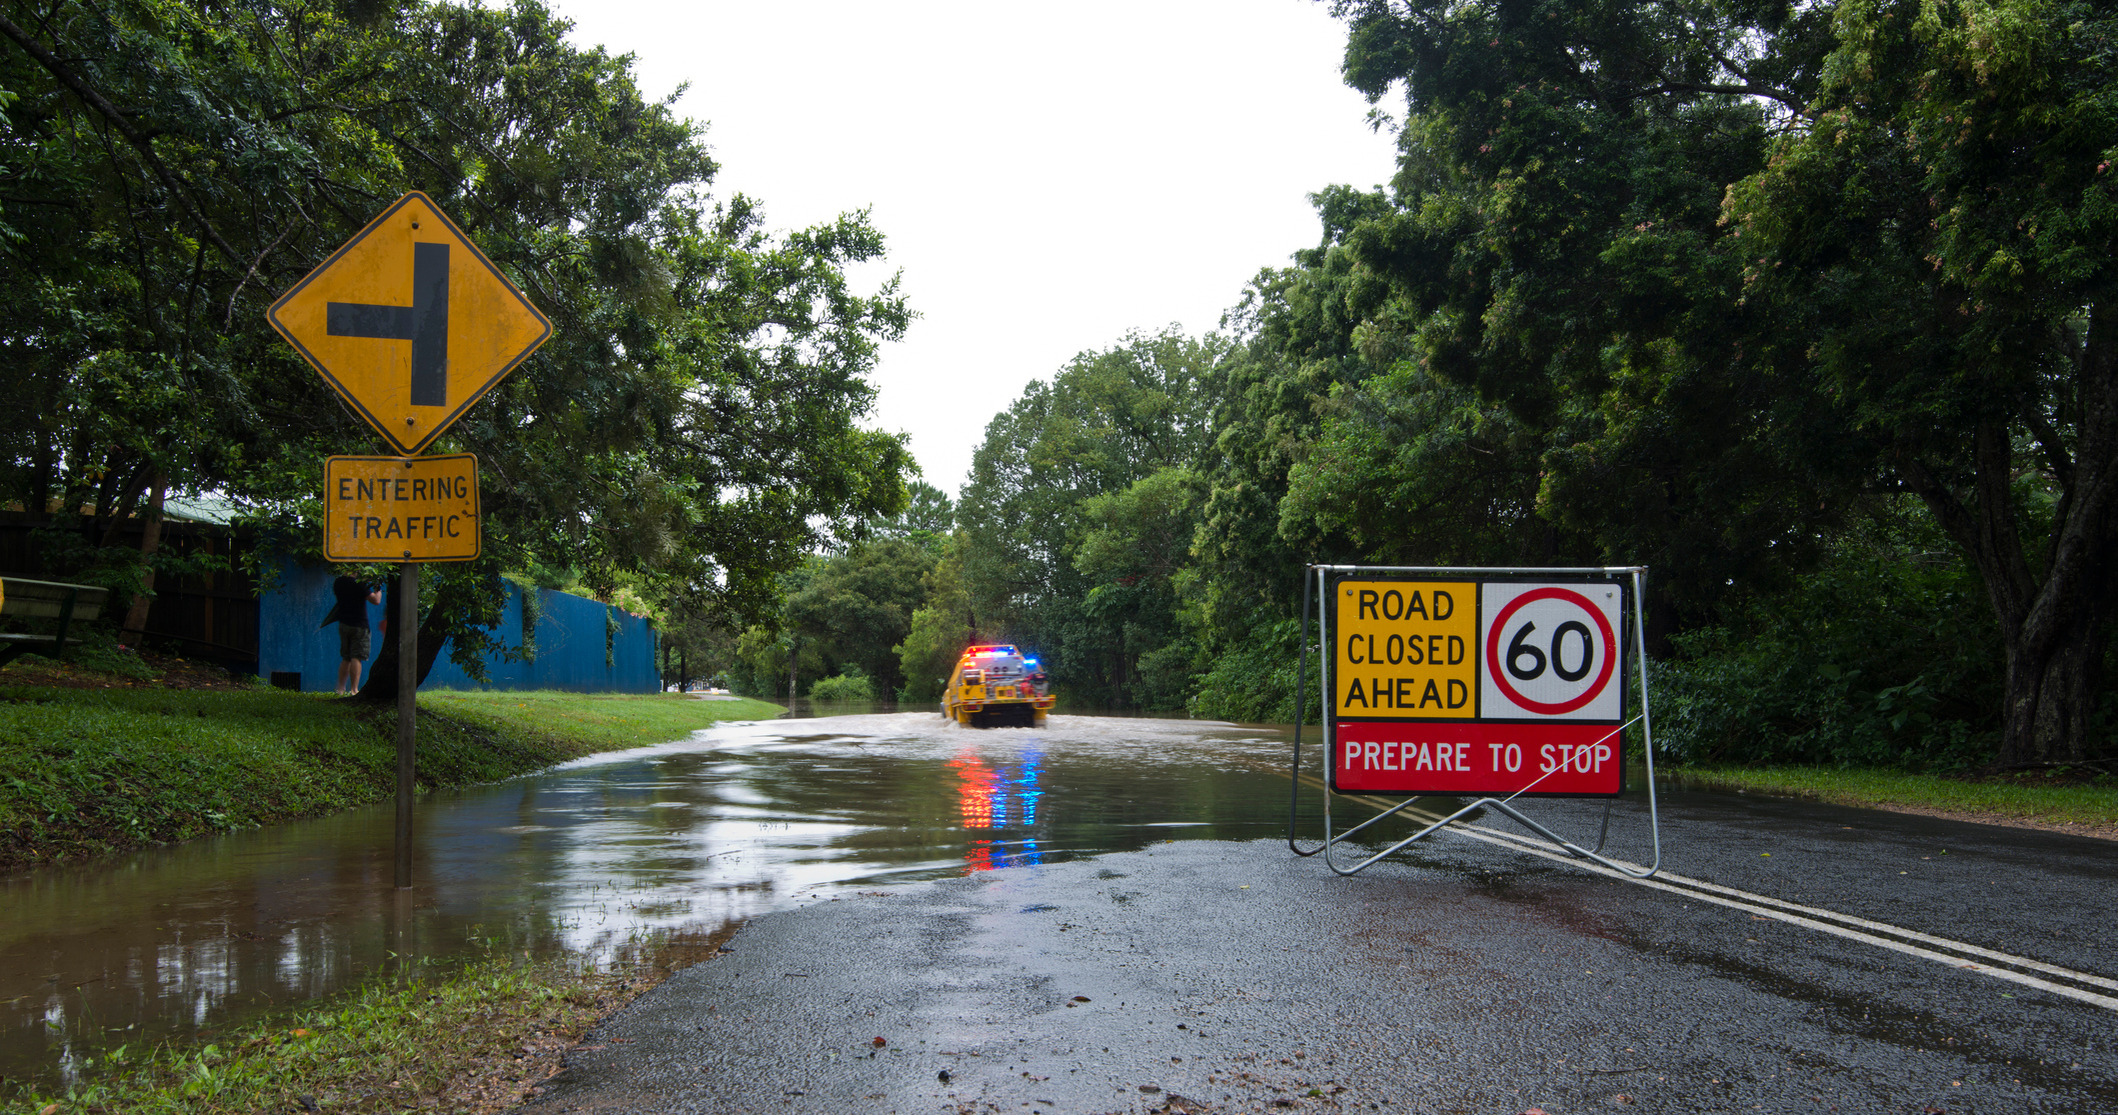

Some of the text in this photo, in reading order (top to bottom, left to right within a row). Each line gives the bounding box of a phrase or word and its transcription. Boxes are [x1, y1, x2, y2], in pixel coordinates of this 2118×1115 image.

[339, 476, 467, 501] ENTERING
[348, 515, 460, 539] TRAFFIC
[1358, 590, 1454, 620] ROAD
[1347, 634, 1465, 665] CLOSED
[1506, 620, 1593, 682] 60
[1344, 678, 1467, 708] AHEAD
[1345, 741, 1612, 774] PREPARE TO STOP
